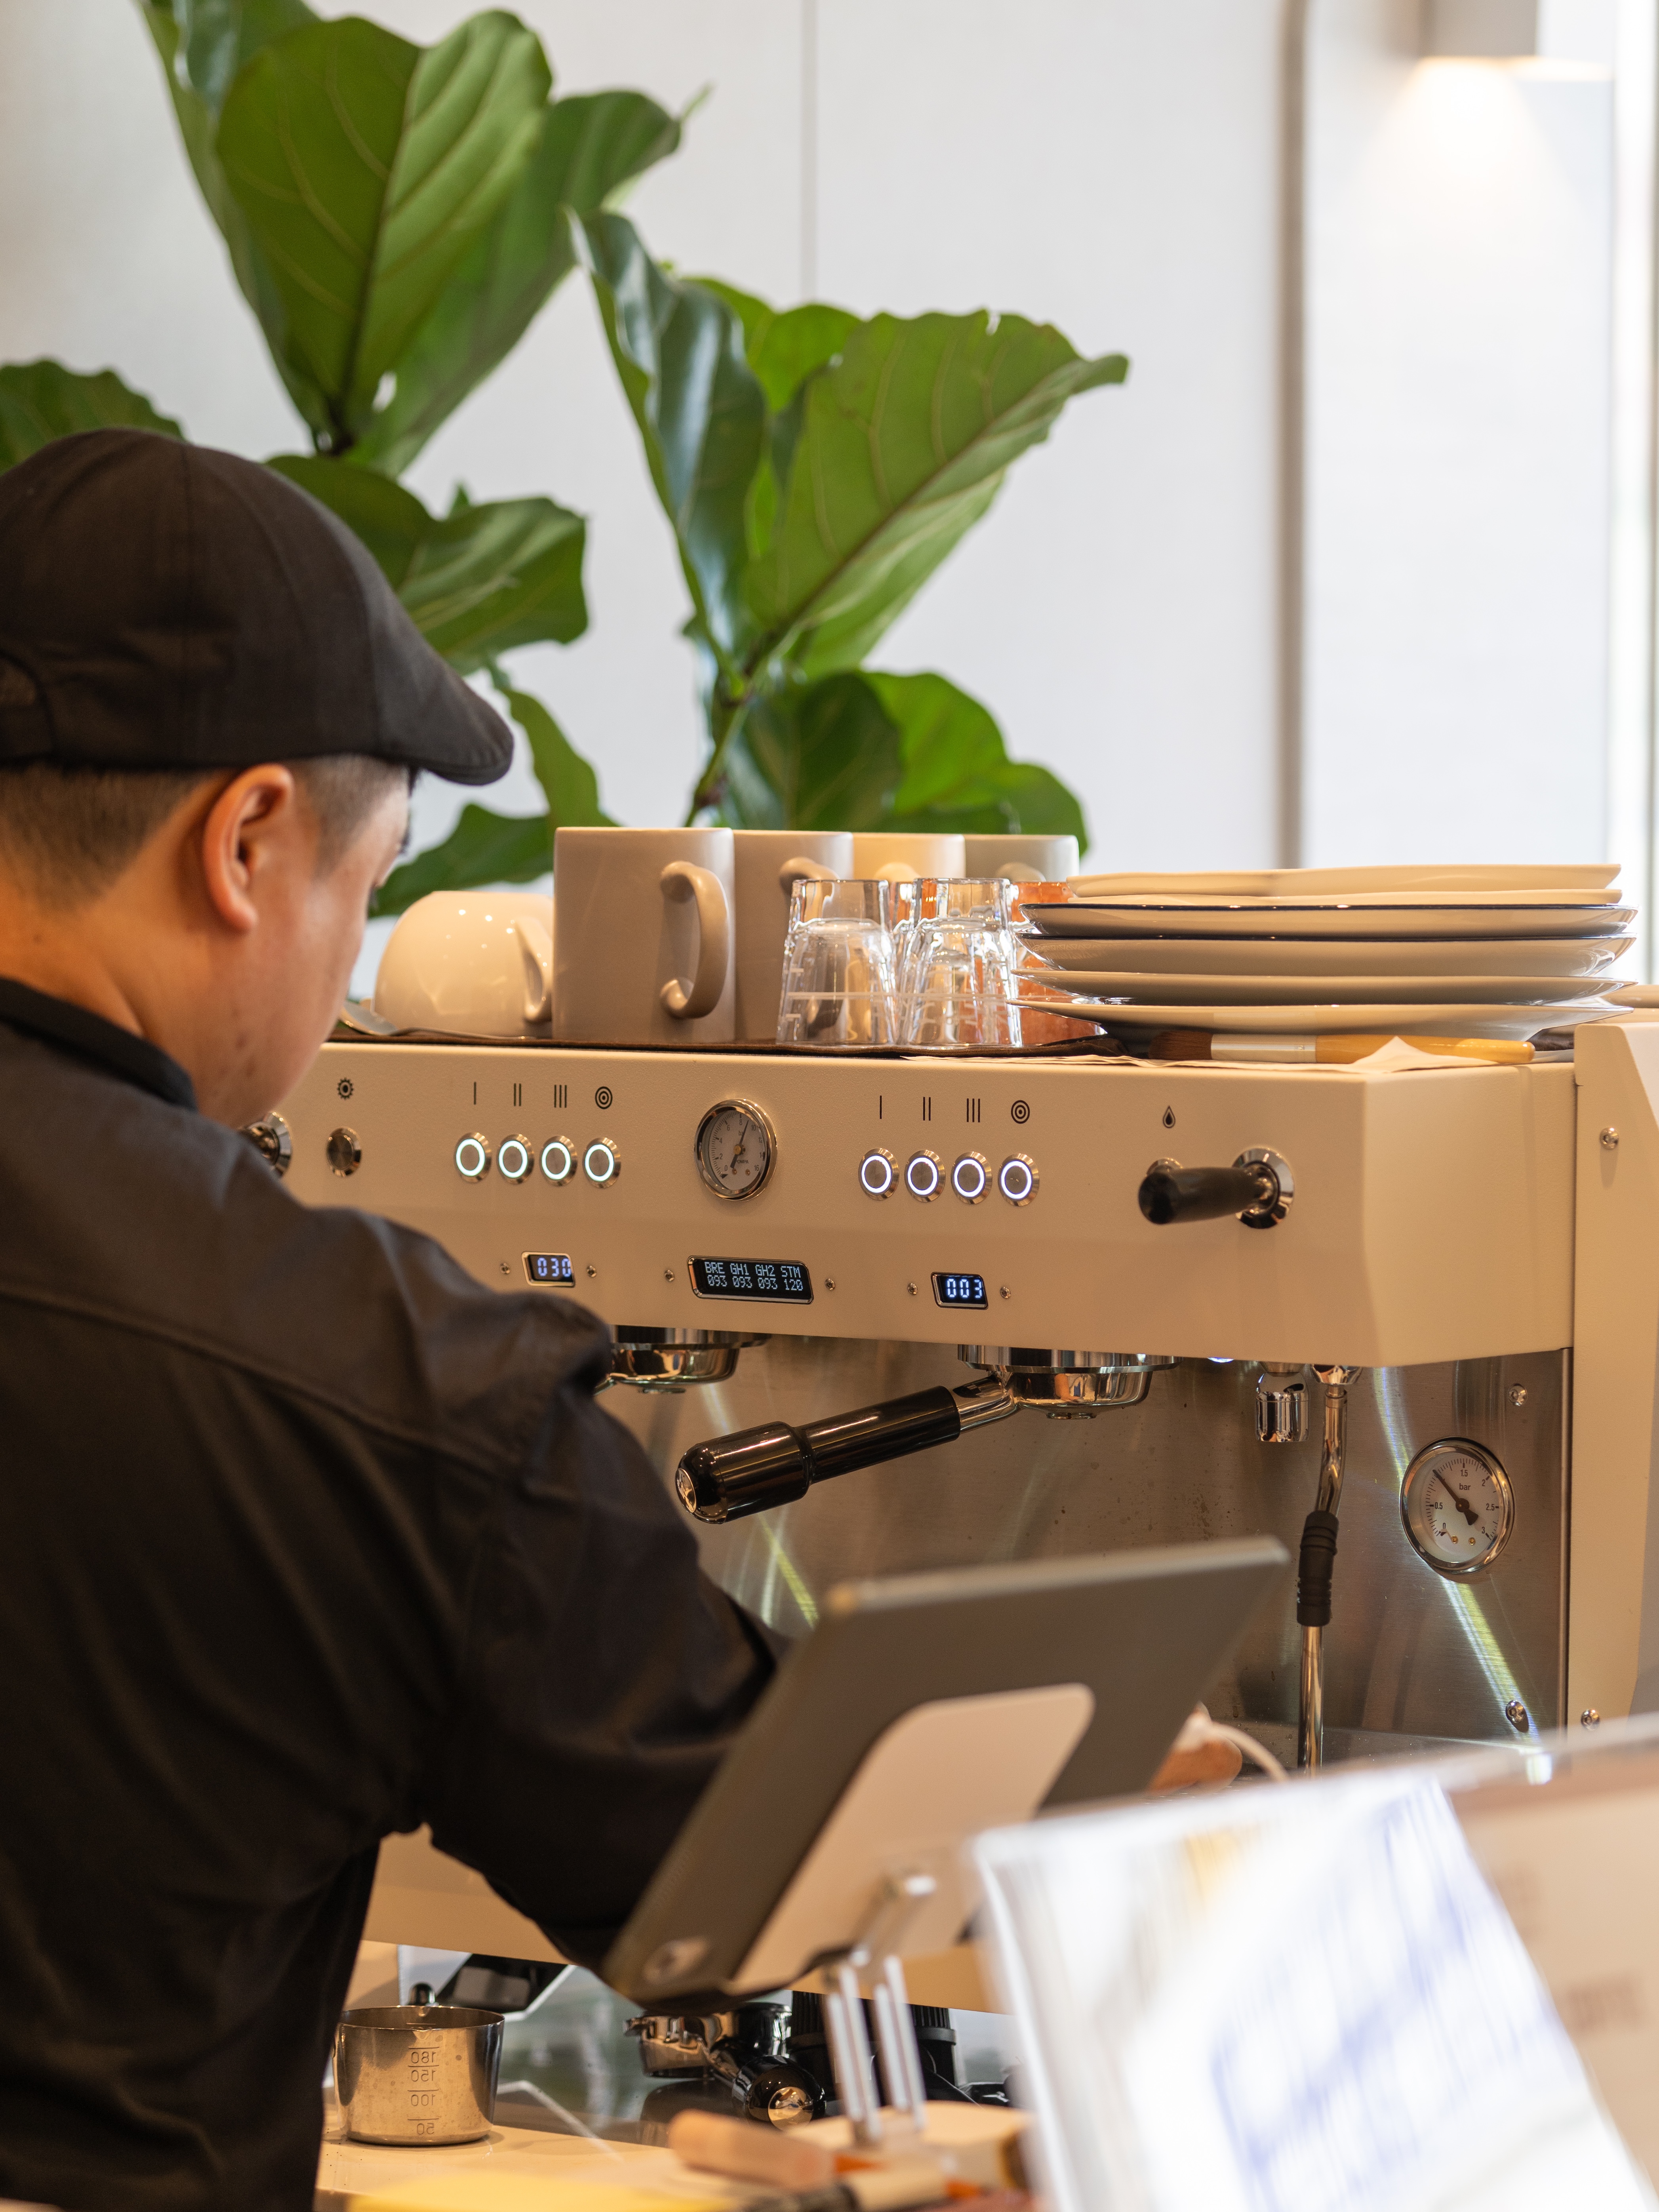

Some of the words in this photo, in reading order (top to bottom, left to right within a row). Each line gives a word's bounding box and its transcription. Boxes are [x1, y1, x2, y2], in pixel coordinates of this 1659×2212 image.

[537, 1257, 571, 1277] 030
[704, 1261, 725, 1274] BRE
[730, 1263, 749, 1275] GH1
[755, 1264, 775, 1277] GH2
[780, 1266, 801, 1278] STM
[707, 1275, 727, 1287] 093
[732, 1276, 752, 1288] 093
[757, 1277, 777, 1290] 093
[784, 1278, 803, 1291] 120
[947, 1278, 982, 1298] 003
